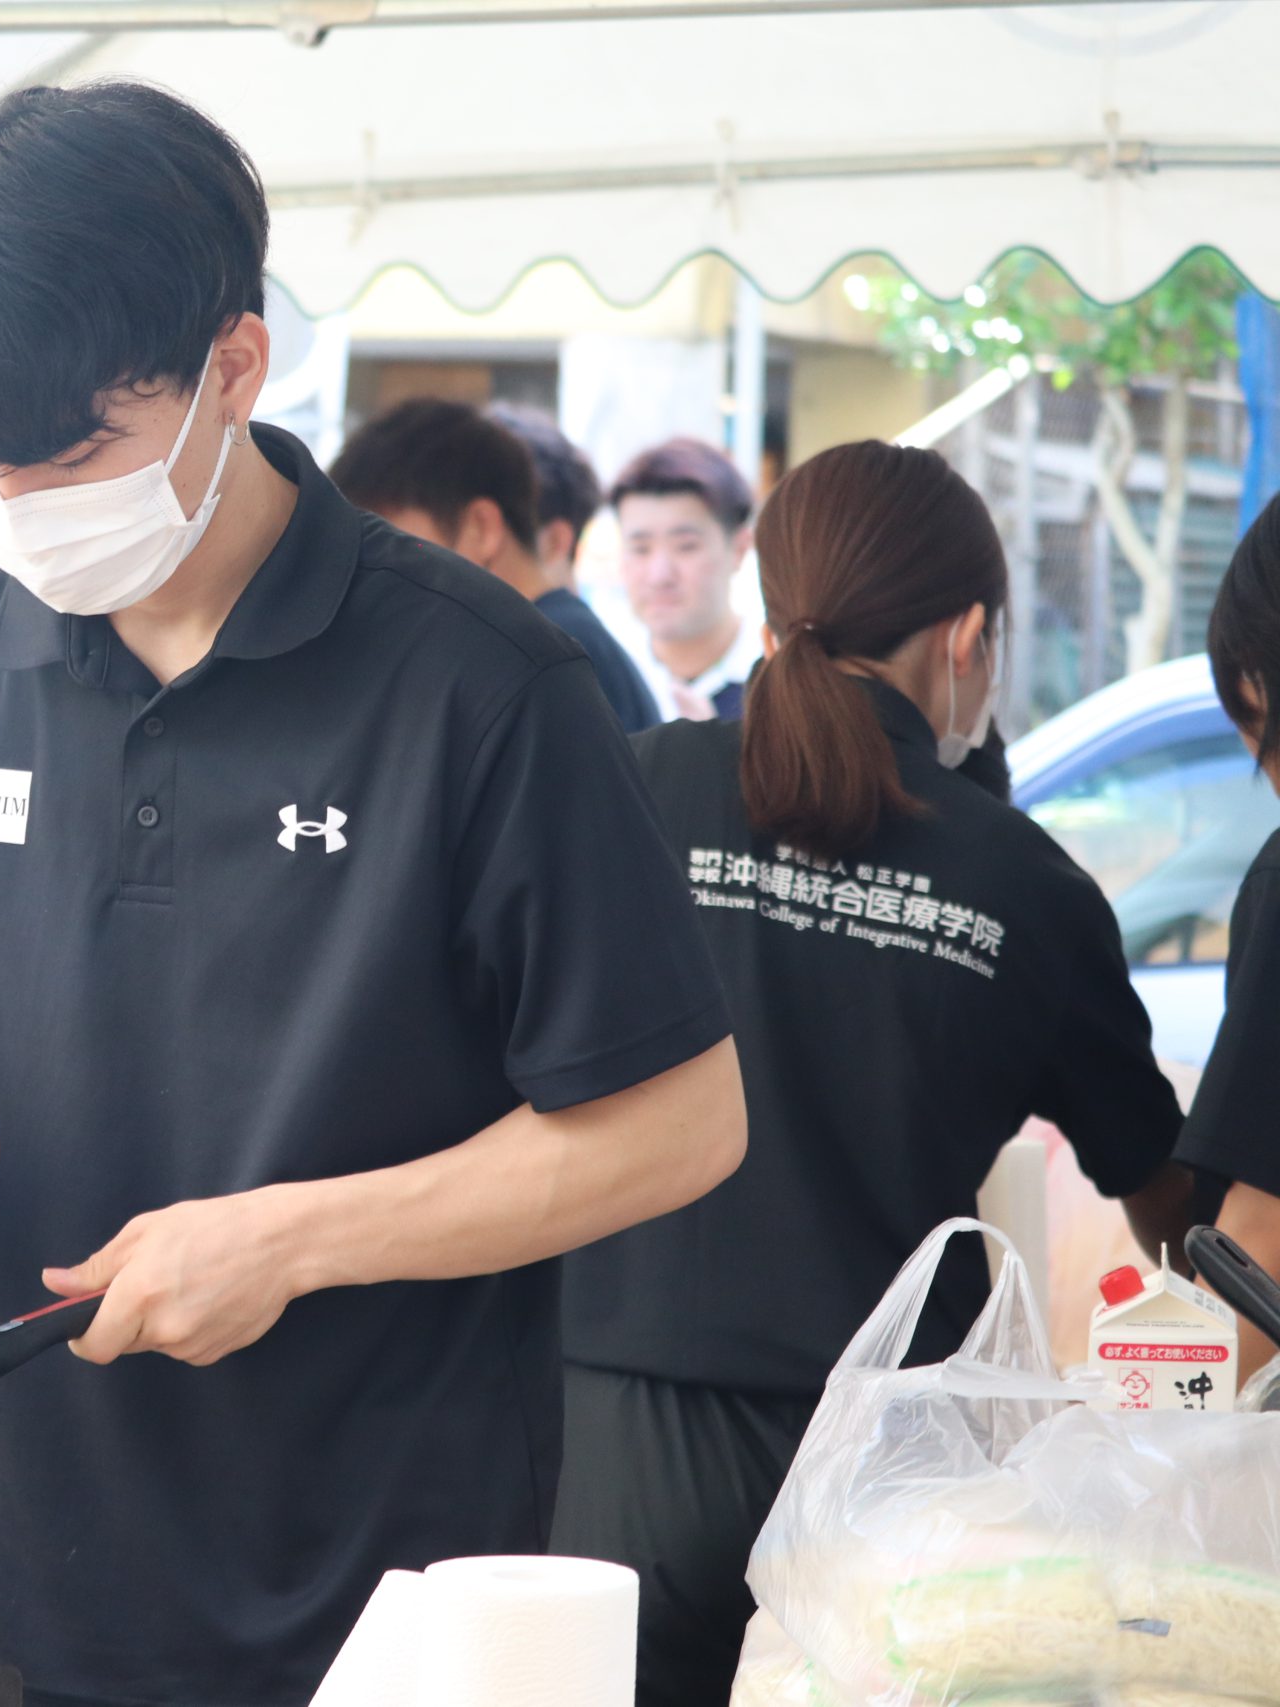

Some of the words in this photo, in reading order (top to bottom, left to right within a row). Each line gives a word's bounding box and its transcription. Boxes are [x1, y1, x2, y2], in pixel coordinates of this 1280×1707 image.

[759, 901, 814, 930] College
[819, 916, 841, 934] of
[846, 921, 929, 953] Integrative
[933, 940, 995, 979] Medicine
